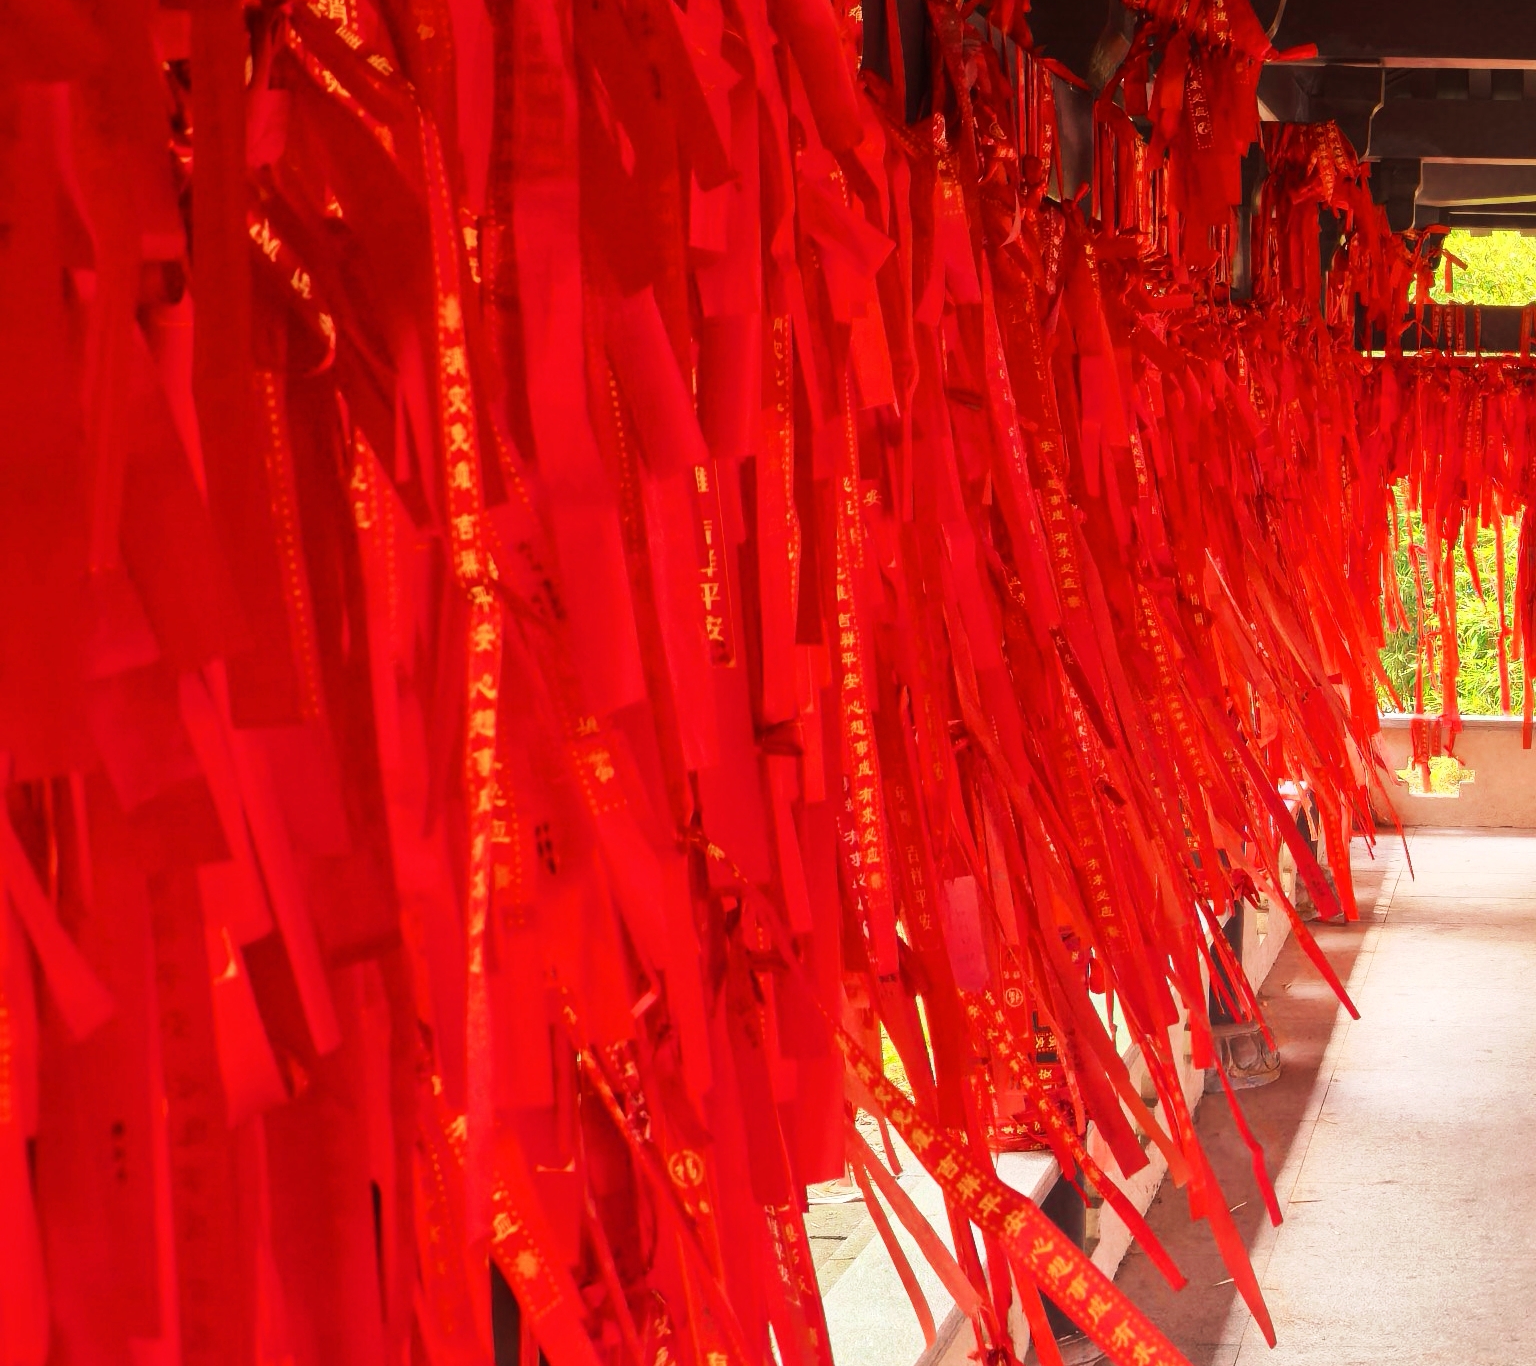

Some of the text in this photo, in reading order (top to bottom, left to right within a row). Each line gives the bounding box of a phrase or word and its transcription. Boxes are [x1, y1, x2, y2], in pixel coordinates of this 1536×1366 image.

[1054, 531, 1078, 590] 有求必应
[847, 701, 873, 775] 心想事成
[858, 787, 881, 864] 有求必应
[936, 1156, 1027, 1238] 吉祥平安
[1026, 1238, 1112, 1323] 心想事成
